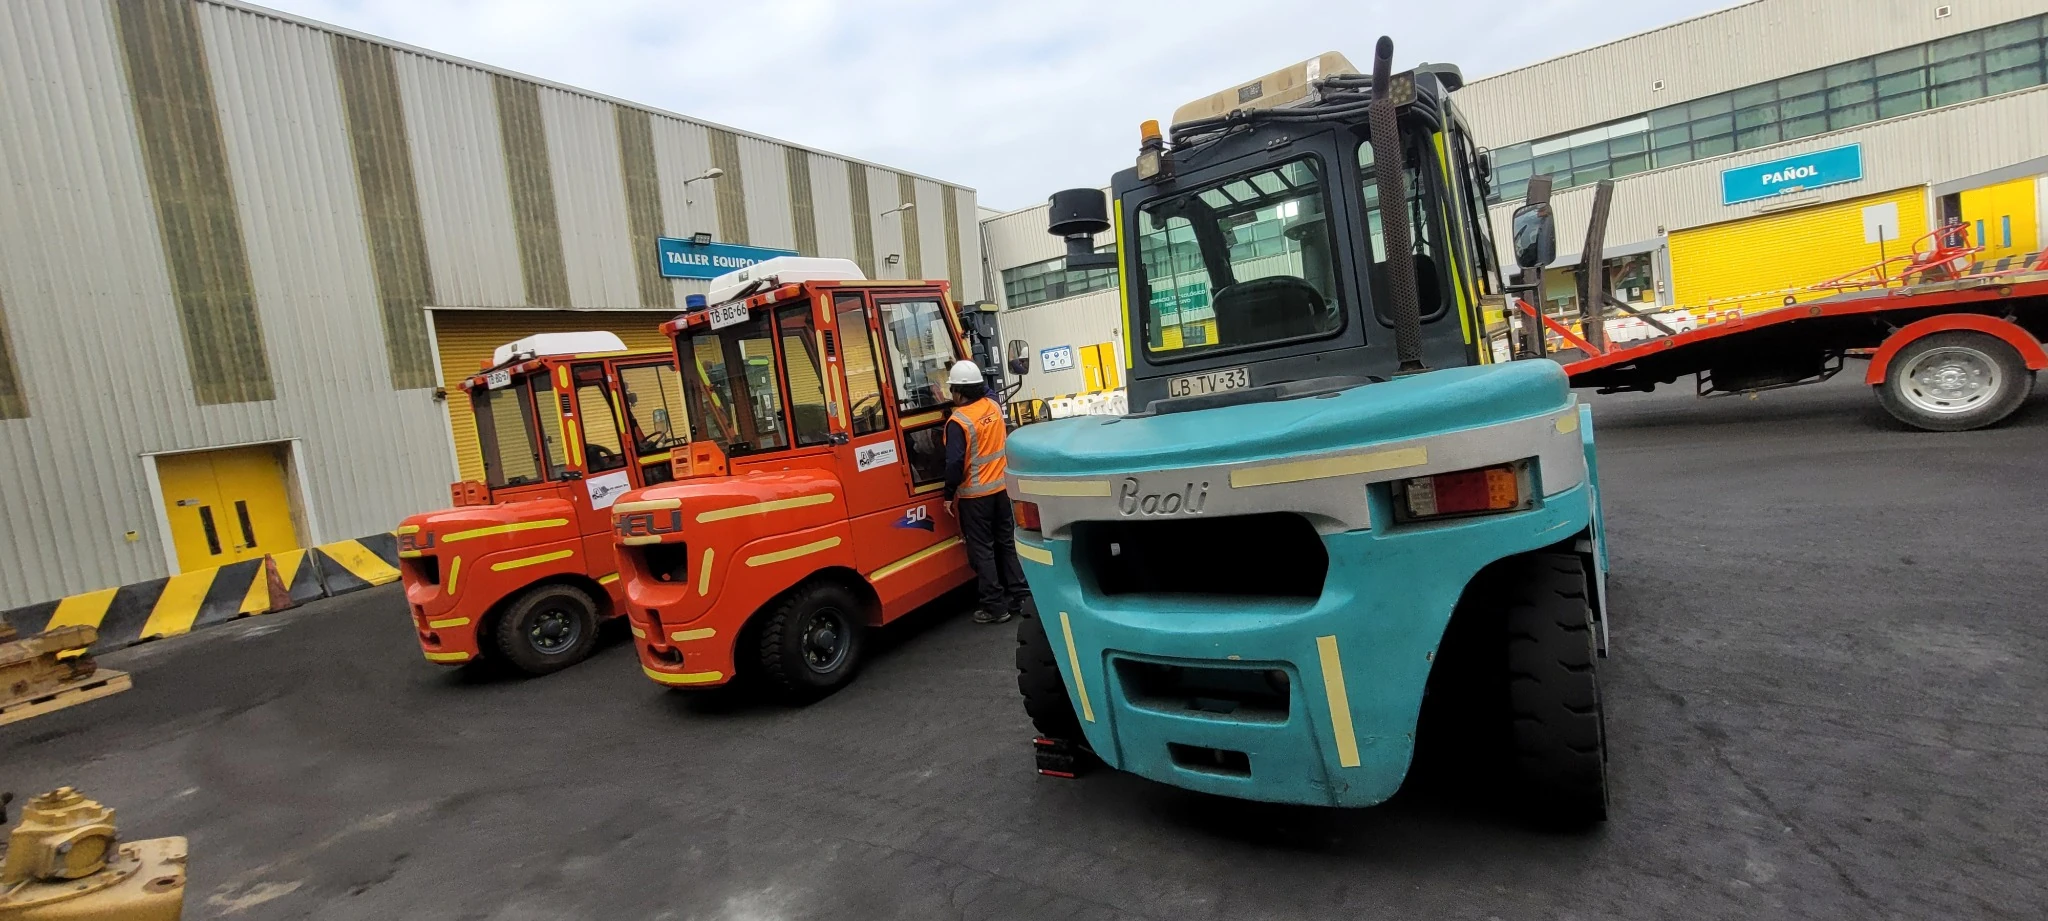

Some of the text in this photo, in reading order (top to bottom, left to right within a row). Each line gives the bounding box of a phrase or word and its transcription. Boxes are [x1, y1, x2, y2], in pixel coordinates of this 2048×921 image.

[1762, 165, 1818, 185] PAÑOL
[666, 251, 755, 268] TALLER EQUIPO
[1171, 289, 1206, 300] TENOLÓGICO
[906, 504, 927, 525] 50
